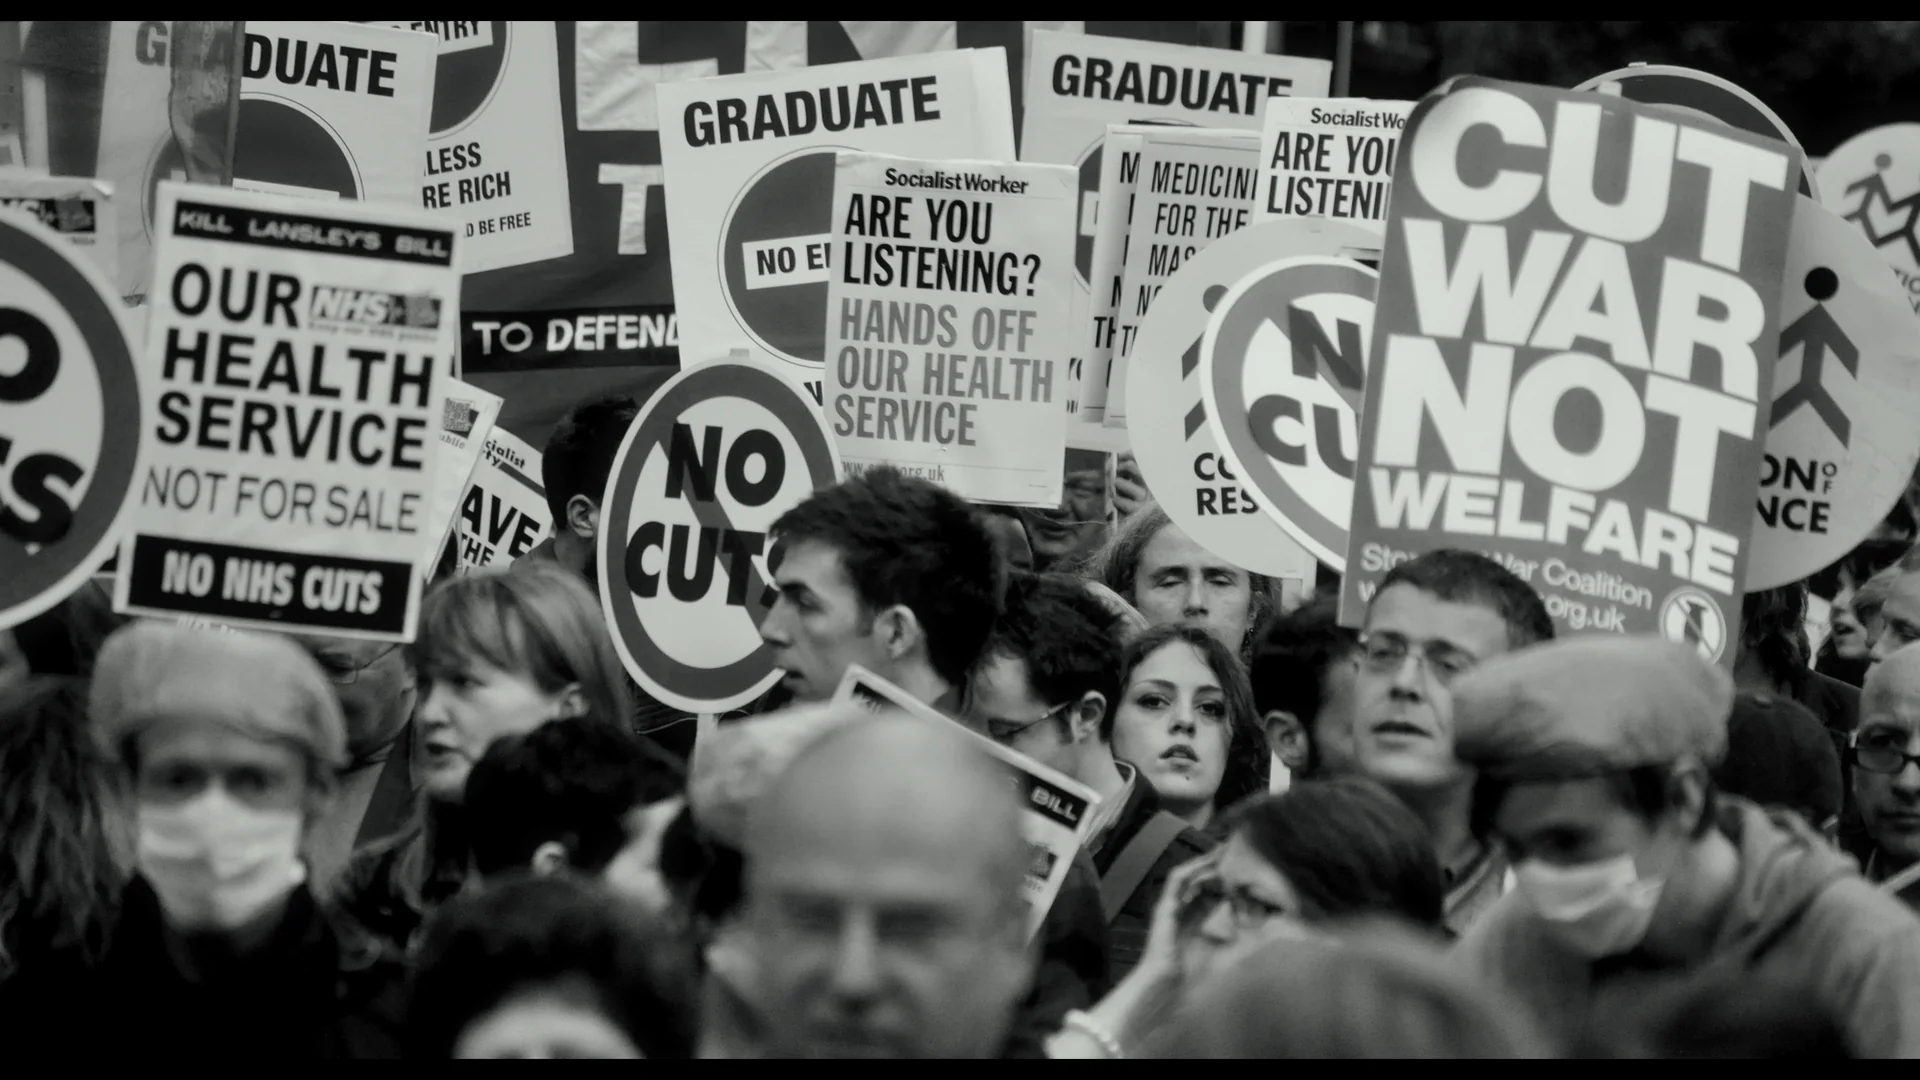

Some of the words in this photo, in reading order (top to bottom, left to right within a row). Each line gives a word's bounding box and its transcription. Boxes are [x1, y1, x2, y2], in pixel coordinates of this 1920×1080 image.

[684, 75, 941, 148] GRADUATE
[1311, 107, 1380, 129] Socialist
[424, 142, 482, 175] LESS
[1271, 132, 1334, 173] ARE
[1410, 87, 1789, 272] CUT
[459, 171, 511, 204] RICH
[885, 167, 962, 191] Socialist
[964, 173, 1029, 195] Worker
[180, 209, 233, 235] KILL
[395, 233, 449, 259] BILL
[479, 219, 496, 236] BE
[500, 212, 532, 232] FREE
[844, 193, 912, 239] ARE
[926, 198, 992, 245] YOU
[1155, 203, 1197, 237] FOR
[757, 246, 796, 277] NO
[844, 242, 1041, 297] LISTENING?
[171, 262, 302, 329] OUR
[309, 284, 390, 325] NHS
[1402, 217, 1765, 402] WAR
[472, 321, 534, 355] TO
[840, 298, 957, 348] HANDS
[972, 307, 1037, 352] OFF
[162, 328, 434, 409] HEALTH
[837, 346, 909, 393] OUR
[923, 352, 1053, 403] HEALTH
[156, 391, 427, 470] SERVICE
[834, 394, 978, 446] SERVICE
[1372, 333, 1758, 523] NOT
[482, 450, 501, 467] ty
[665, 422, 786, 507] NO
[142, 465, 229, 514] NOT
[235, 475, 318, 526] FOR
[325, 485, 422, 535] SALE
[462, 533, 495, 567] HE
[1369, 468, 1740, 595] WELFARE
[160, 549, 215, 598] NO
[222, 556, 297, 607] NHS
[302, 565, 385, 615] CUTS
[624, 520, 780, 607] CUT
[1542, 557, 1653, 611] Coalition
[1031, 785, 1078, 822] BILL
